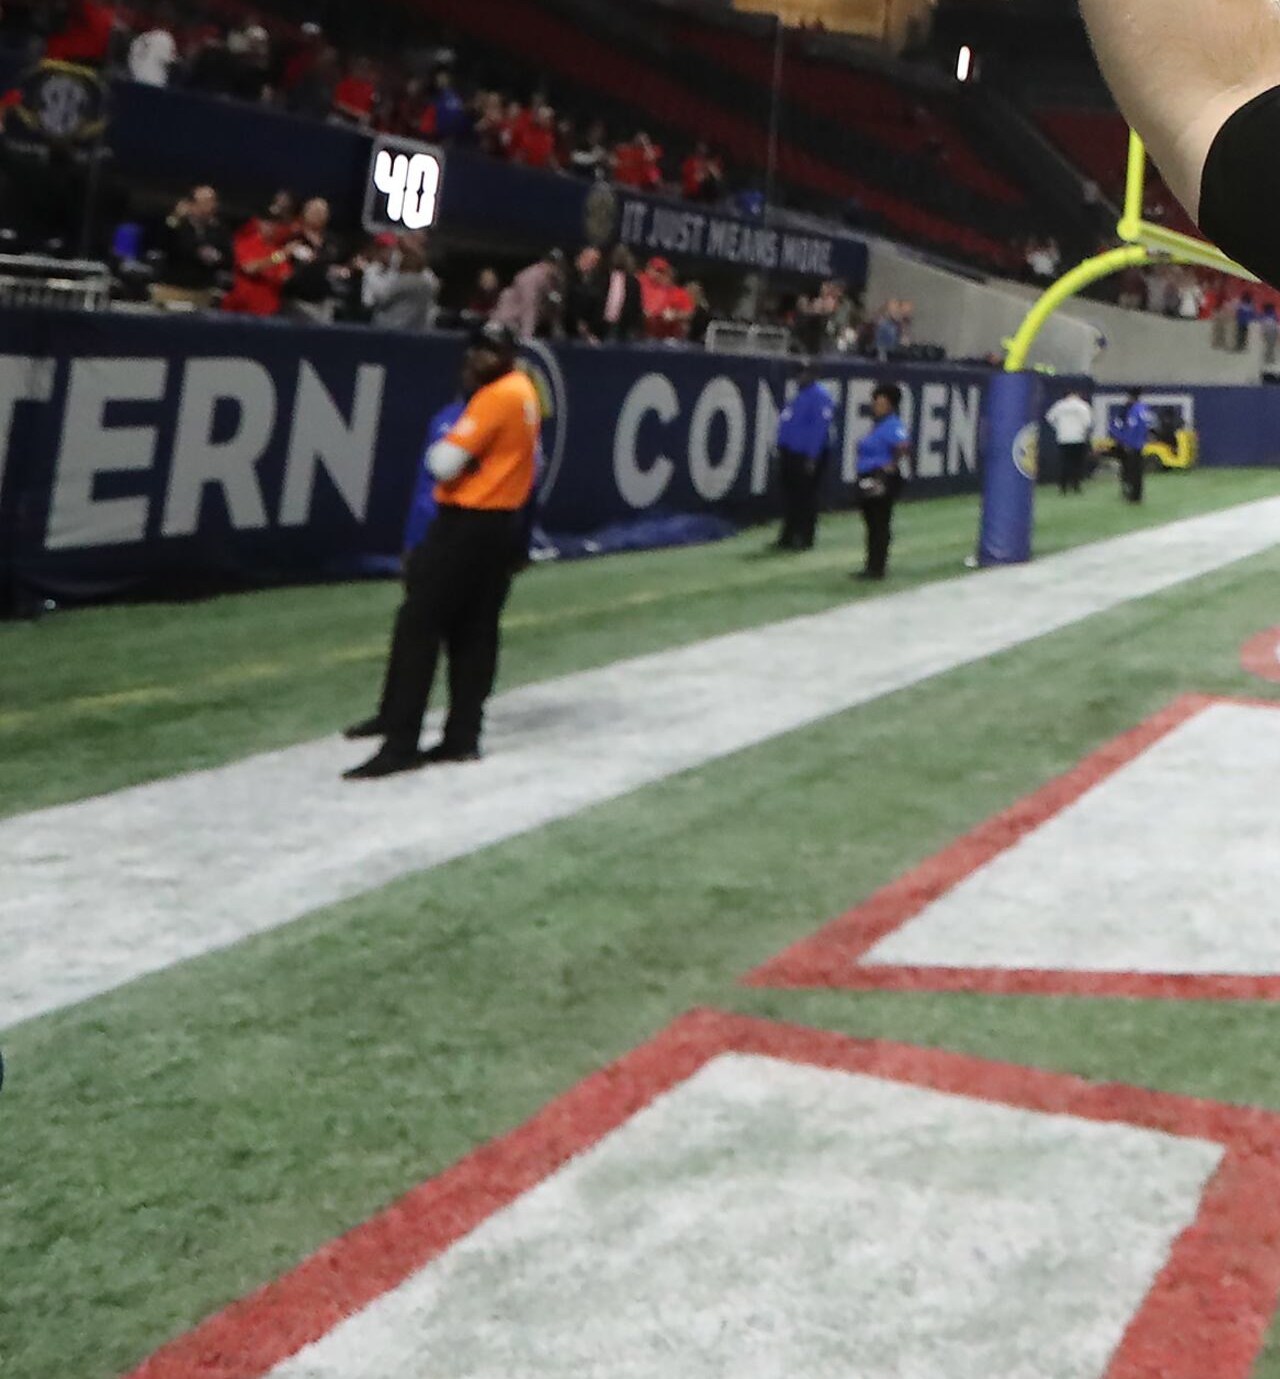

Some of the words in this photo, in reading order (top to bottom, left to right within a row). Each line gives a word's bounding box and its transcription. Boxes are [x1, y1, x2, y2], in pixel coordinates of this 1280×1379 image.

[374, 151, 437, 229] 40
[646, 207, 706, 256] JUST
[705, 219, 778, 268] MEANS
